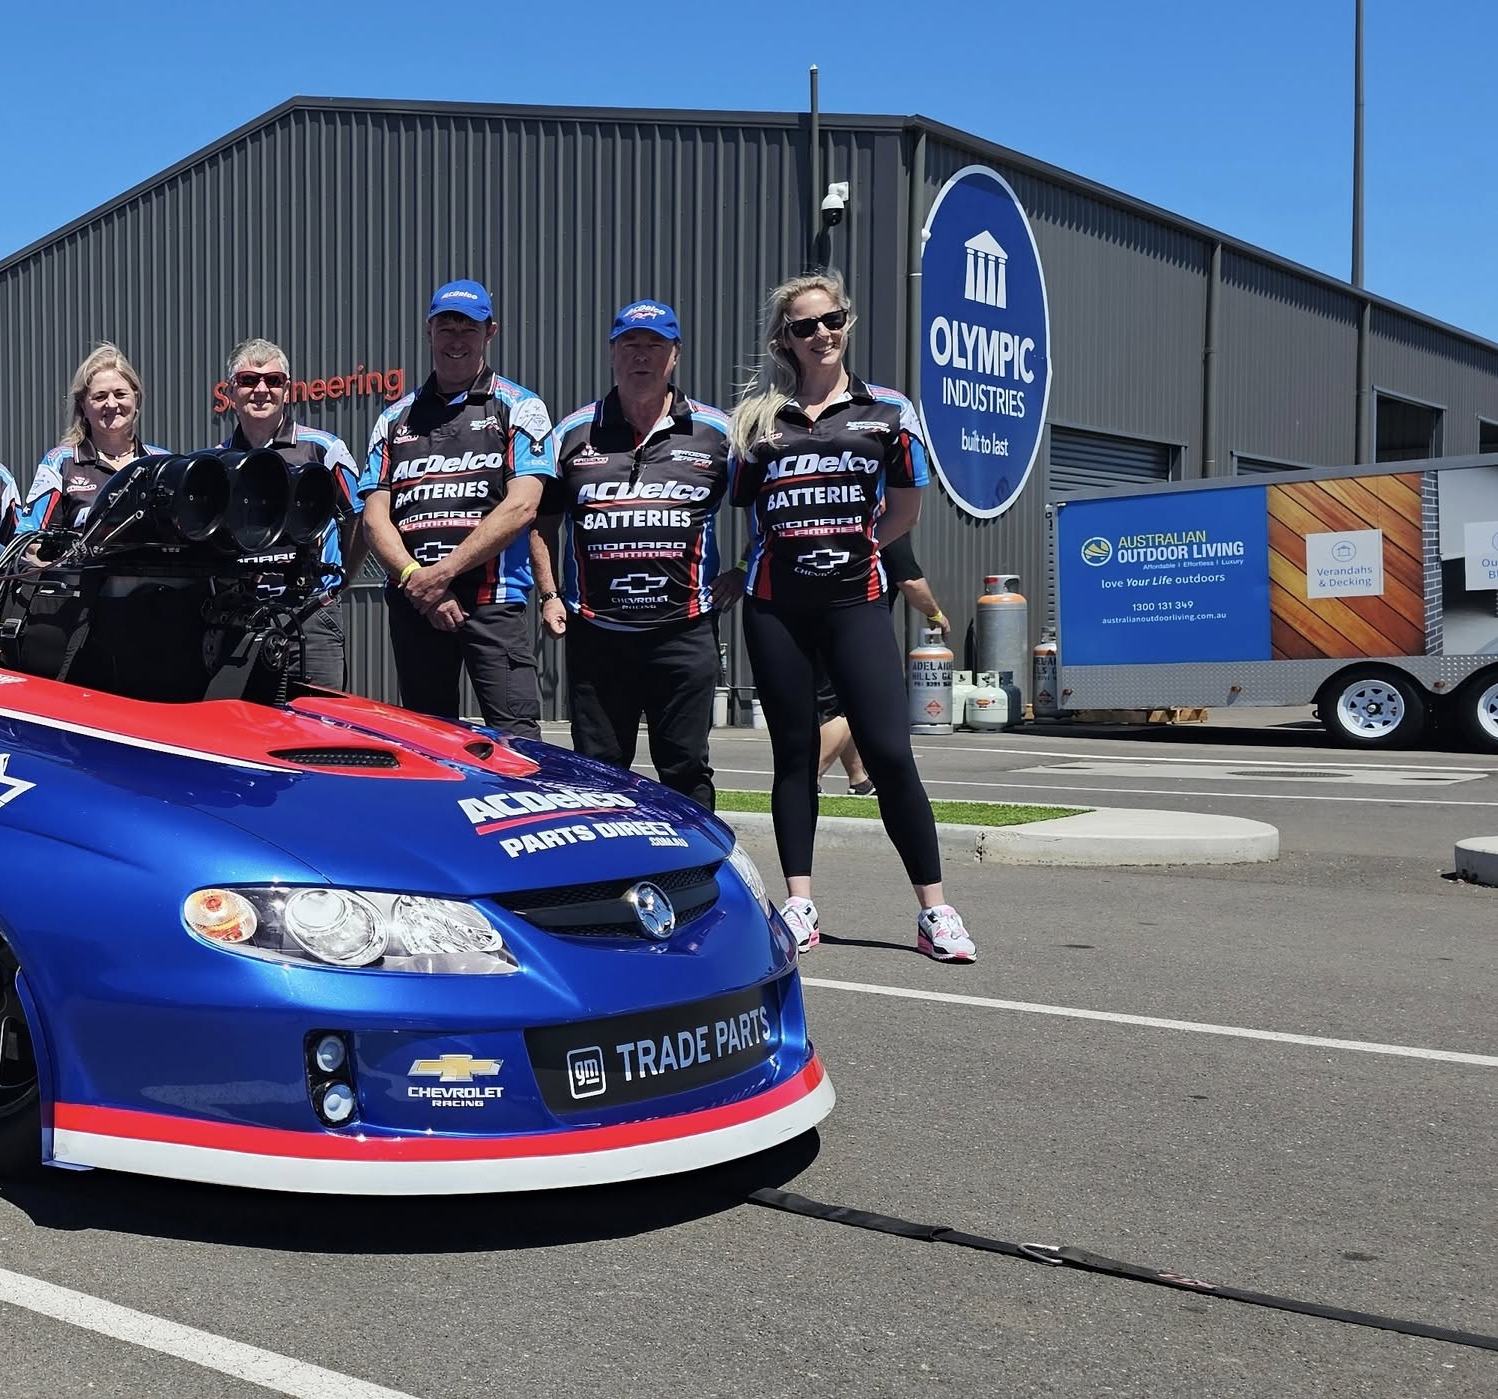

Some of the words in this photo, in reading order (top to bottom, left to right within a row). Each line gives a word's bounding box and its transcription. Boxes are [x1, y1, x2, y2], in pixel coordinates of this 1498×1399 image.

[930, 316, 1035, 384] OLYMPIC
[942, 376, 1025, 418] INDUSTRIES
[961, 427, 980, 452] built
[980, 434, 991, 454] to
[992, 432, 1009, 456] last
[392, 451, 503, 483] ACDelco
[764, 452, 879, 483] ACDelco
[395, 480, 489, 509] BATTERIES
[577, 480, 711, 504] ACDelco
[398, 510, 483, 527] MONARO
[583, 509, 692, 530] BATTERIES
[588, 541, 687, 551] MONARO
[1117, 530, 1207, 549] AUSTRALIAN
[590, 551, 684, 560] SLAMMER
[1117, 544, 1189, 563] OUTDOOR
[1193, 541, 1244, 559] LIVING
[1143, 562, 1176, 570] Affordable
[1183, 560, 1214, 568] Effortless
[1221, 558, 1244, 566] Luxury
[1316, 565, 1373, 577] Verandahs
[1101, 579, 1124, 588] love
[1126, 578, 1150, 587] Your
[1152, 575, 1173, 586] Life
[1175, 573, 1226, 584] outdoors
[1318, 579, 1326, 587] &
[1329, 577, 1372, 588] Decking
[1132, 602, 1155, 611] 1300
[1157, 601, 1172, 610] 131
[1175, 600, 1194, 609] 349
[1101, 612, 1227, 624] australianoutdoorliving.com.au
[457, 790, 638, 825] ACDelco
[500, 824, 594, 859] PARTS
[599, 820, 679, 840] DIRECT
[616, 1025, 711, 1083] TRADE
[715, 1006, 772, 1058] PARTS
[407, 1086, 504, 1099] CHEVROLET
[431, 1099, 484, 1108] RACING
